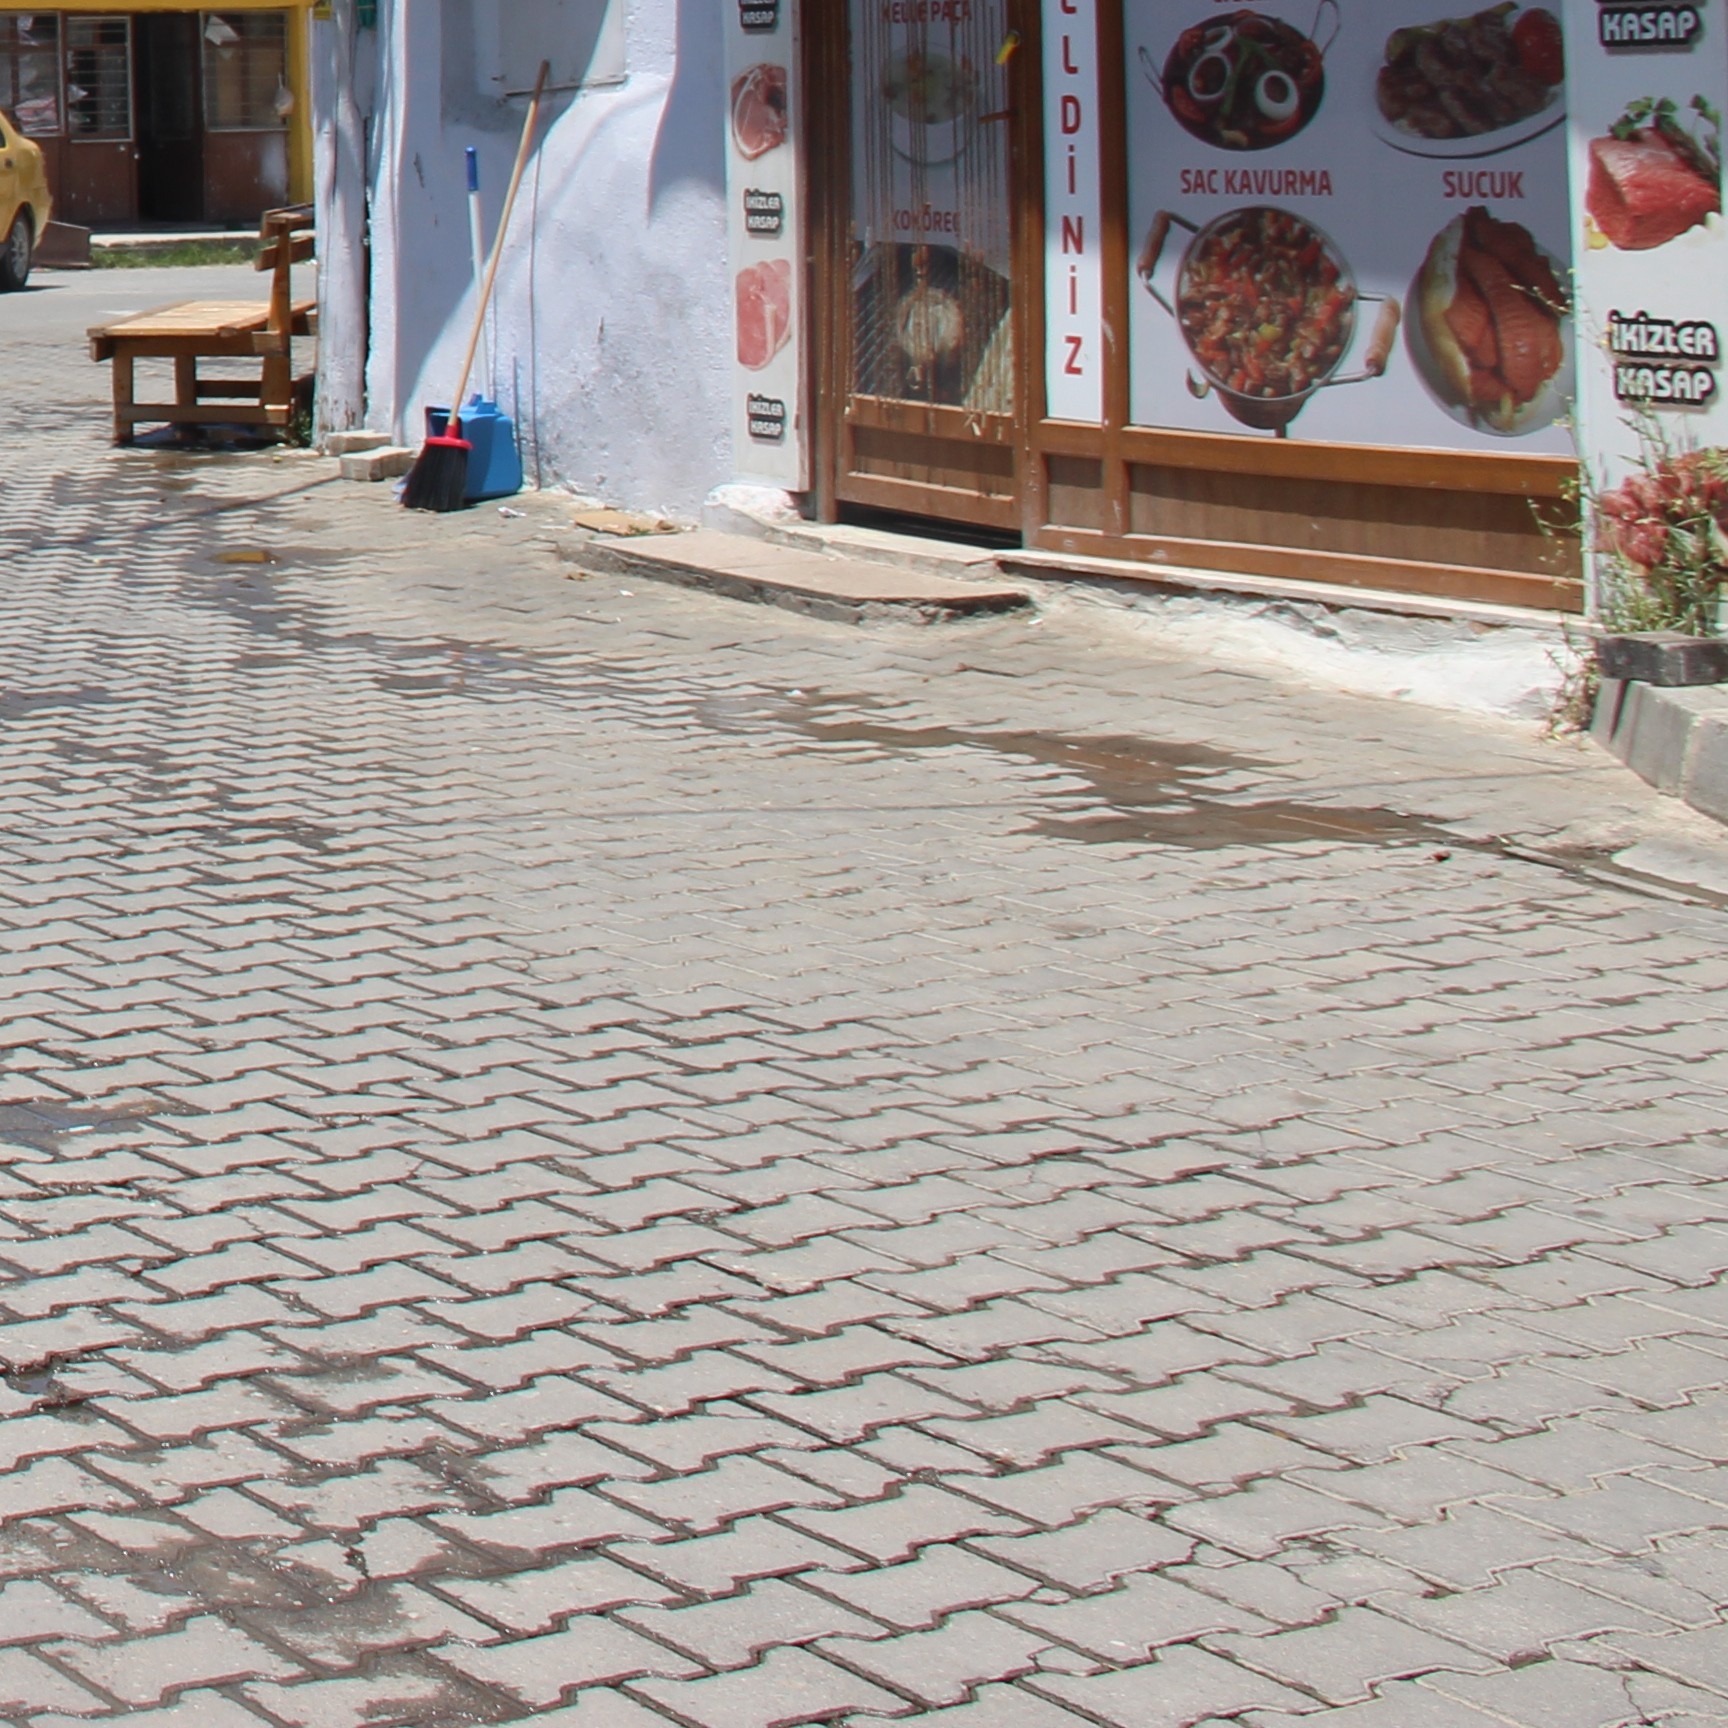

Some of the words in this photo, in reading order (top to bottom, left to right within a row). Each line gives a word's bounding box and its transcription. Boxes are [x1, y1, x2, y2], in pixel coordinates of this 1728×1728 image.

[1602, 10, 1697, 41] KASAP
[1180, 168, 1218, 195] SAC
[1224, 168, 1334, 197] KAVURMA
[1443, 170, 1525, 199] SUCUK
[1616, 367, 1713, 400] KASAP
